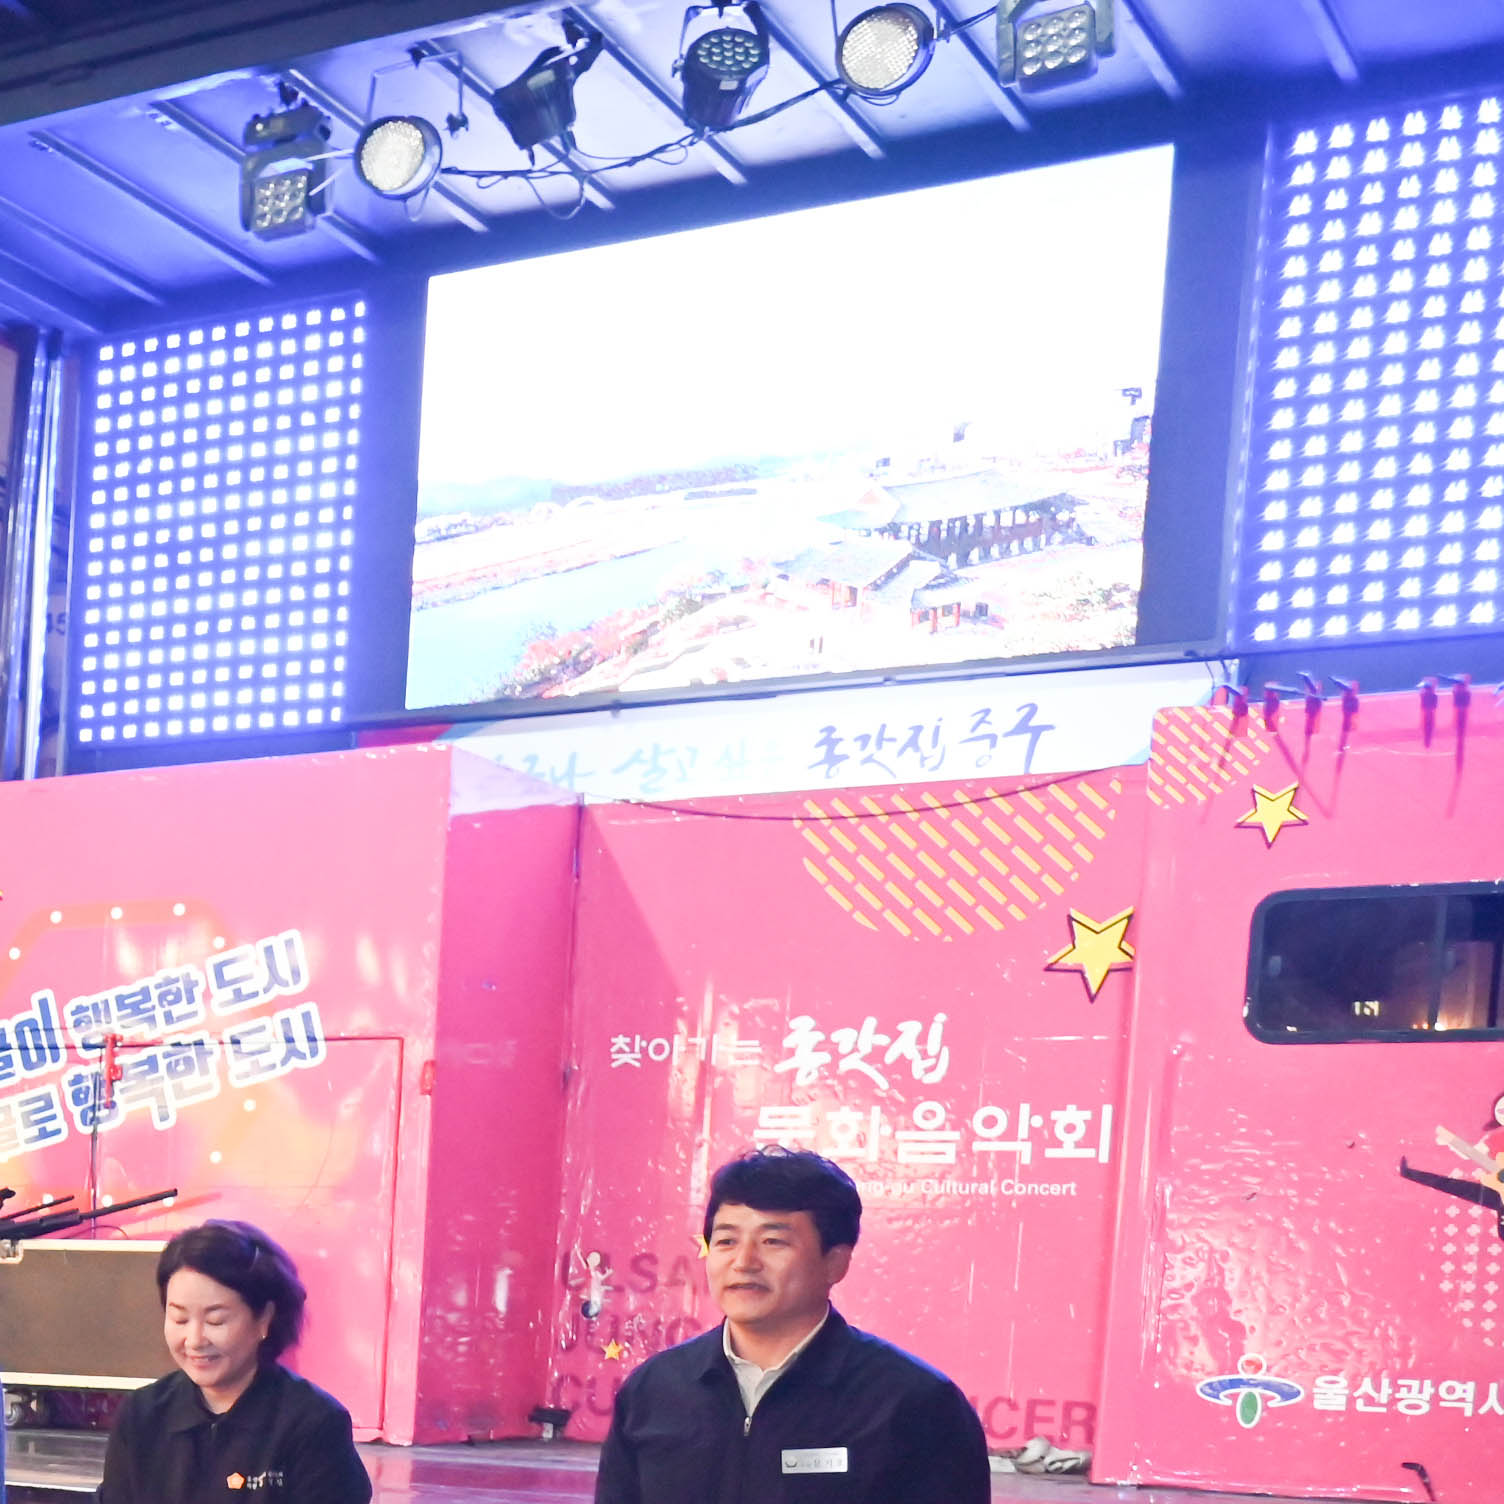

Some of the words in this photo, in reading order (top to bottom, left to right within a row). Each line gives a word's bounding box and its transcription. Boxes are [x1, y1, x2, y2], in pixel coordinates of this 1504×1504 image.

[959, 702, 1056, 775] 중구
[70, 971, 199, 1052] 행복한
[211, 937, 302, 1007] 도시
[67, 1038, 215, 1127] 행복한
[228, 1010, 319, 1082] 도시
[753, 1100, 1114, 1165] 문화음악회
[921, 1179, 995, 1196] Cultural
[1001, 1180, 1077, 1197] Concert
